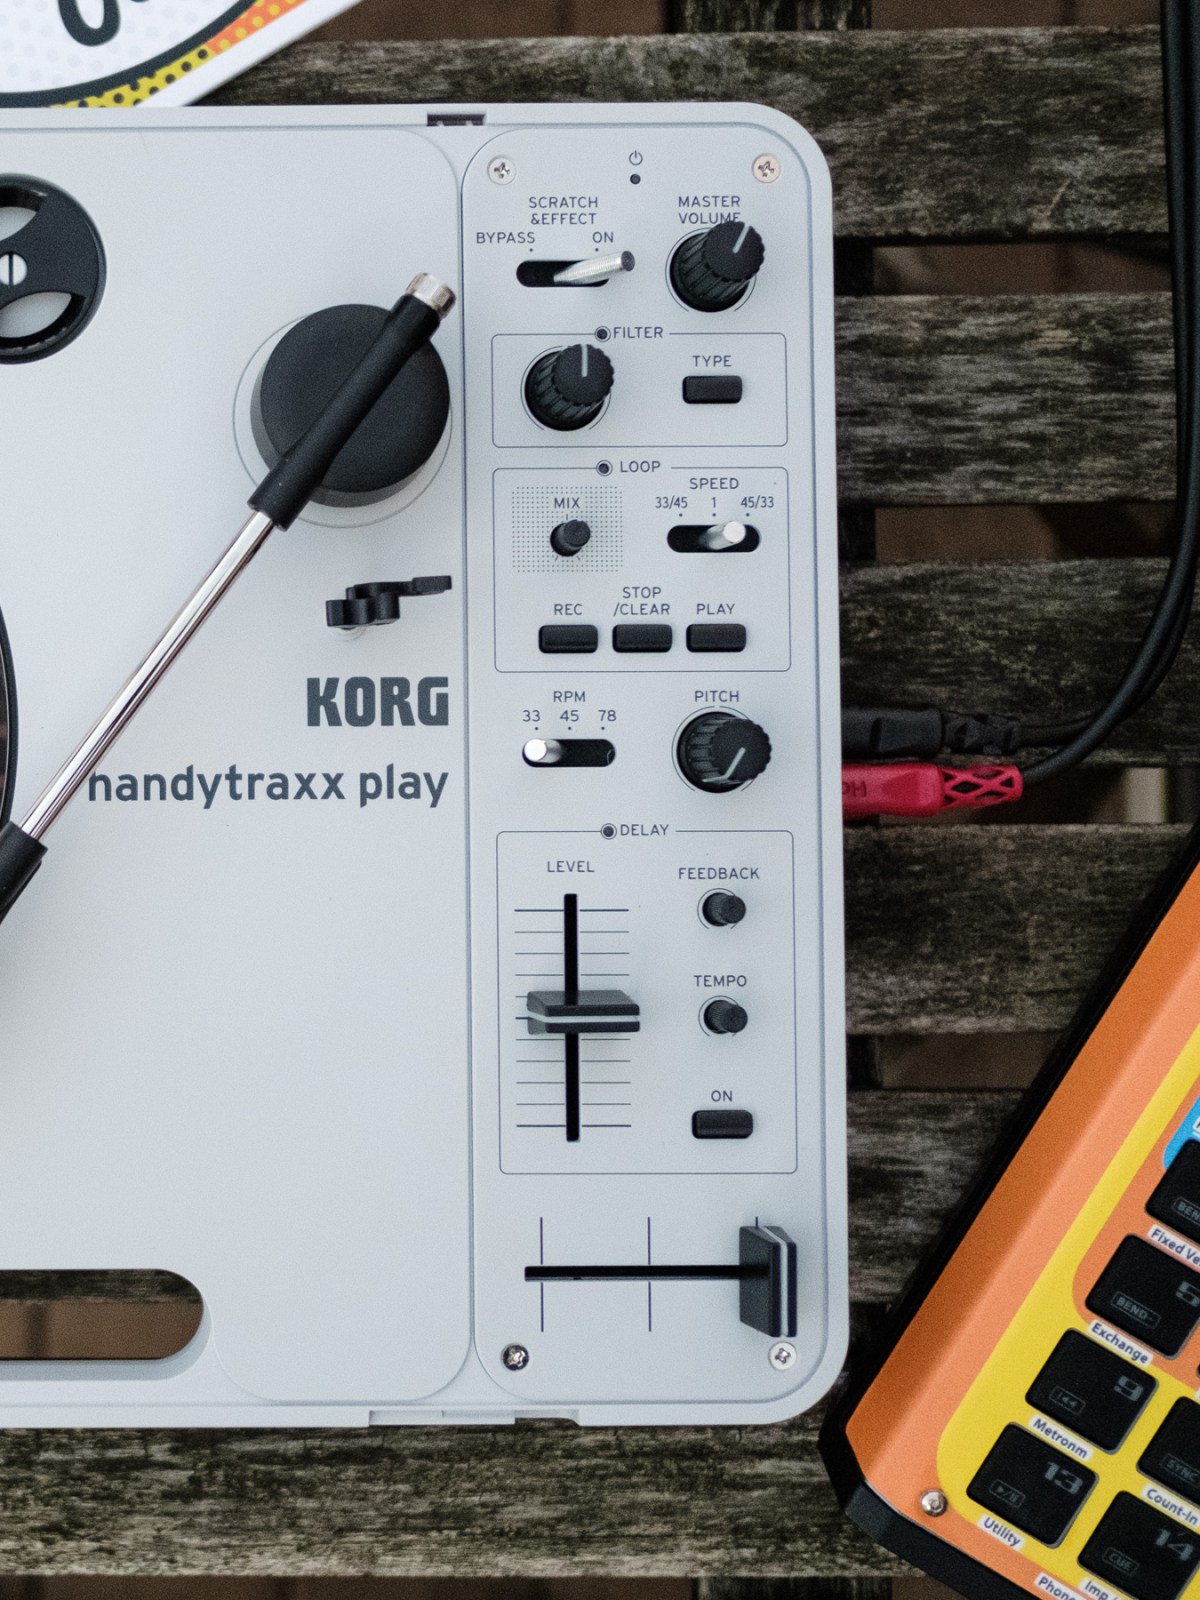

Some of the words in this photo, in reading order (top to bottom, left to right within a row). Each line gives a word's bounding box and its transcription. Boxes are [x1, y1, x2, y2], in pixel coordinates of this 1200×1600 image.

[528, 195, 599, 209] SCRATCH
[678, 195, 741, 208] MASTER
[530, 212, 597, 226] &EFFECT
[678, 212, 741, 225] VOLUME
[475, 231, 536, 245] BYPASS
[592, 231, 614, 244] ON
[613, 326, 664, 340] FILTER
[692, 355, 732, 368] TYPE
[619, 460, 662, 473] LOOP
[689, 477, 740, 490] SPEED
[553, 497, 581, 509] MIX
[655, 496, 689, 510] 33/45
[740, 495, 775, 510] 45/33
[622, 586, 662, 599] STOP
[553, 603, 583, 616] REC
[612, 602, 671, 617] /CLEAR
[696, 603, 736, 616] PLAY
[306, 675, 450, 727] KORG
[553, 690, 586, 703] RPM
[694, 690, 740, 703] PITCH
[522, 709, 541, 722] 33
[559, 709, 580, 722] 45
[597, 709, 617, 722] 78
[88, 764, 346, 809] handytraxx
[360, 763, 450, 808] play
[619, 823, 670, 837] DELAY
[547, 860, 596, 873] LEVEL
[678, 867, 761, 880] FEEDBACK
[694, 975, 748, 988] TEMPO
[711, 1090, 733, 1102] ON
[1151, 1228, 1185, 1254] Fixed
[1186, 1247, 1200, 1267] Ve
[1175, 1280, 1200, 1307] 5
[1091, 1322, 1149, 1365] Exchange
[1114, 1375, 1144, 1401] 9
[1033, 1418, 1088, 1459] Metronm
[1044, 1461, 1084, 1495] 13
[1146, 1488, 1198, 1526] Count-In
[984, 1516, 1022, 1547] Utility
[1155, 1528, 1195, 1563] 14
